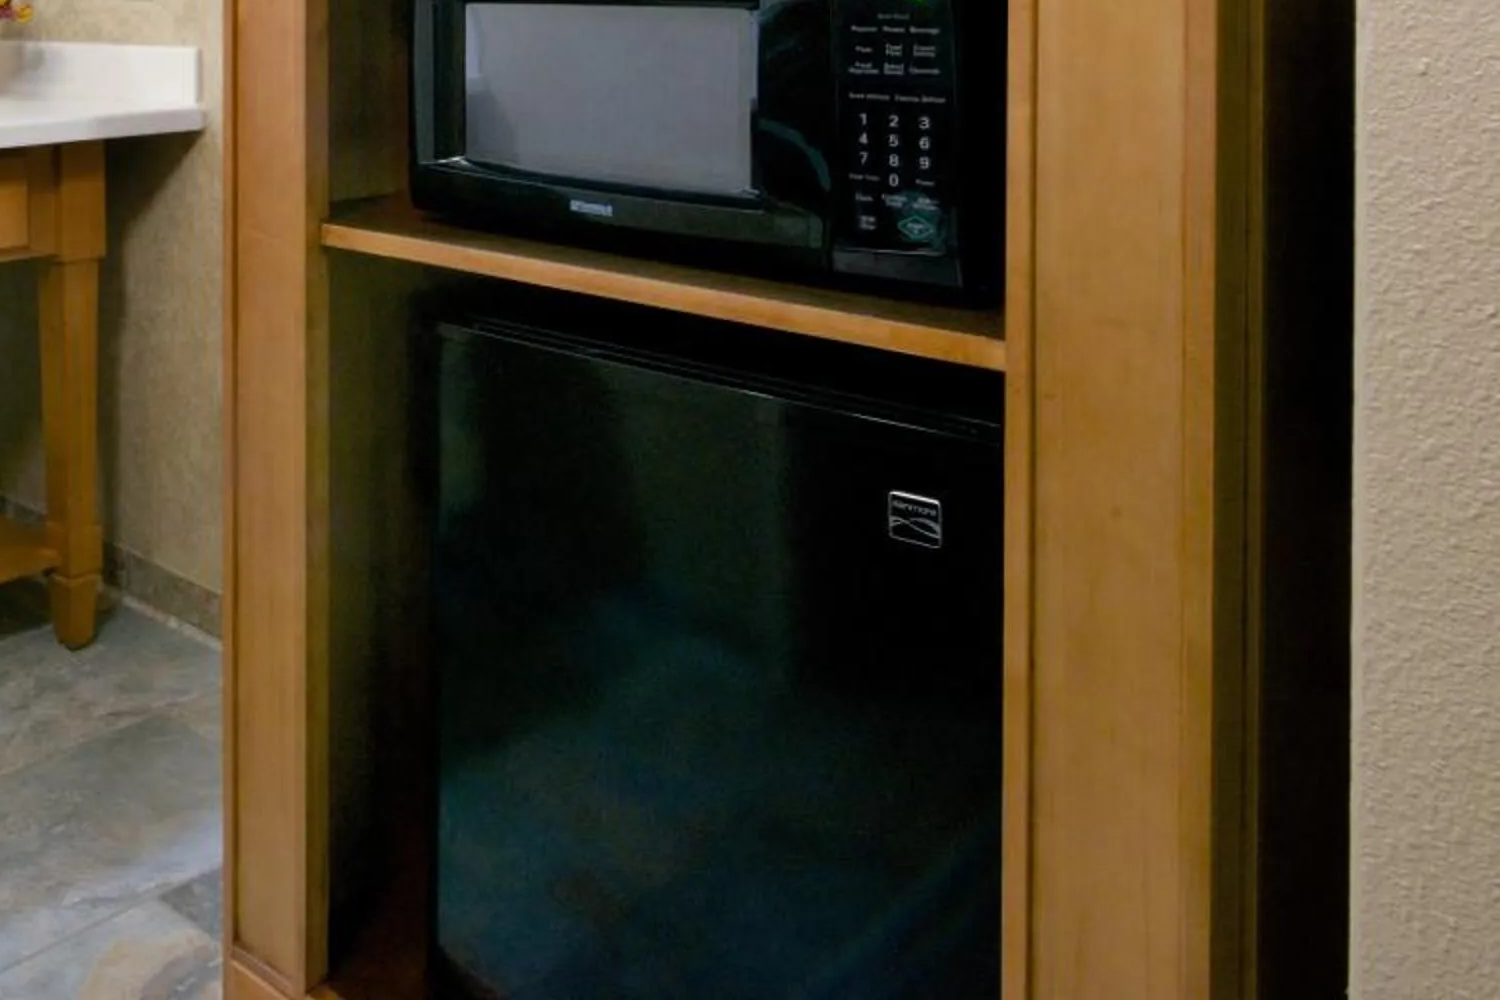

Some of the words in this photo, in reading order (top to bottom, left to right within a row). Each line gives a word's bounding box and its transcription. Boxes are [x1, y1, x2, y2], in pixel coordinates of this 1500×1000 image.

[858, 112, 868, 126] 1
[888, 114, 900, 128] 2
[918, 115, 931, 130] 3
[858, 131, 869, 145] 4
[888, 133, 900, 148] 5
[918, 136, 931, 151] 6
[858, 151, 869, 166] 7
[888, 153, 900, 167] 8
[918, 156, 931, 170] 9
[888, 172, 900, 188] 0
